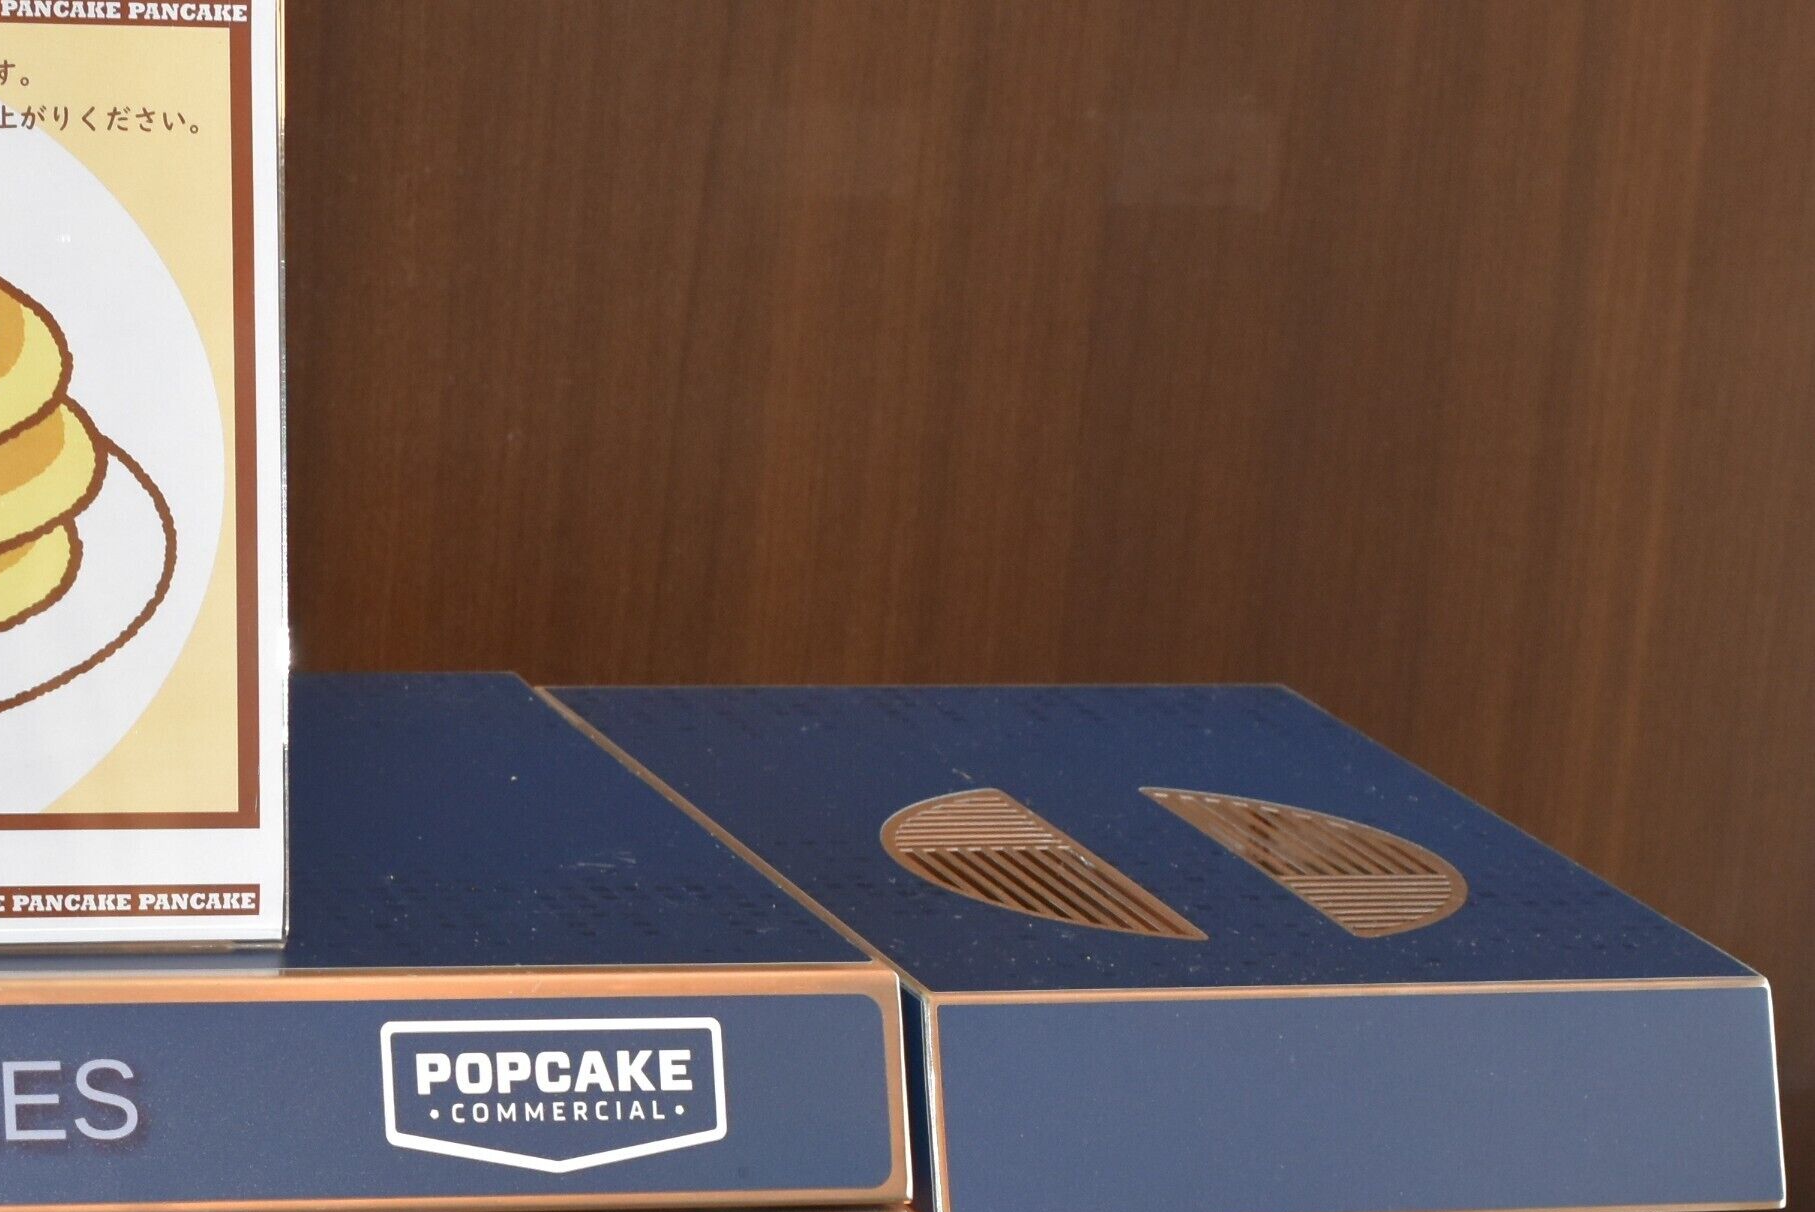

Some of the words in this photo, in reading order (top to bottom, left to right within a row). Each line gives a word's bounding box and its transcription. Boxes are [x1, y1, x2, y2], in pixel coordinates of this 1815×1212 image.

[0, 0, 121, 20] PANCAKE
[127, 2, 248, 23] PANCAKE
[12, 893, 132, 912] PANCAKE
[138, 891, 257, 911] PANCAKE
[415, 1049, 694, 1096] POPCAKE
[451, 1100, 666, 1124] COMMERCIAL
